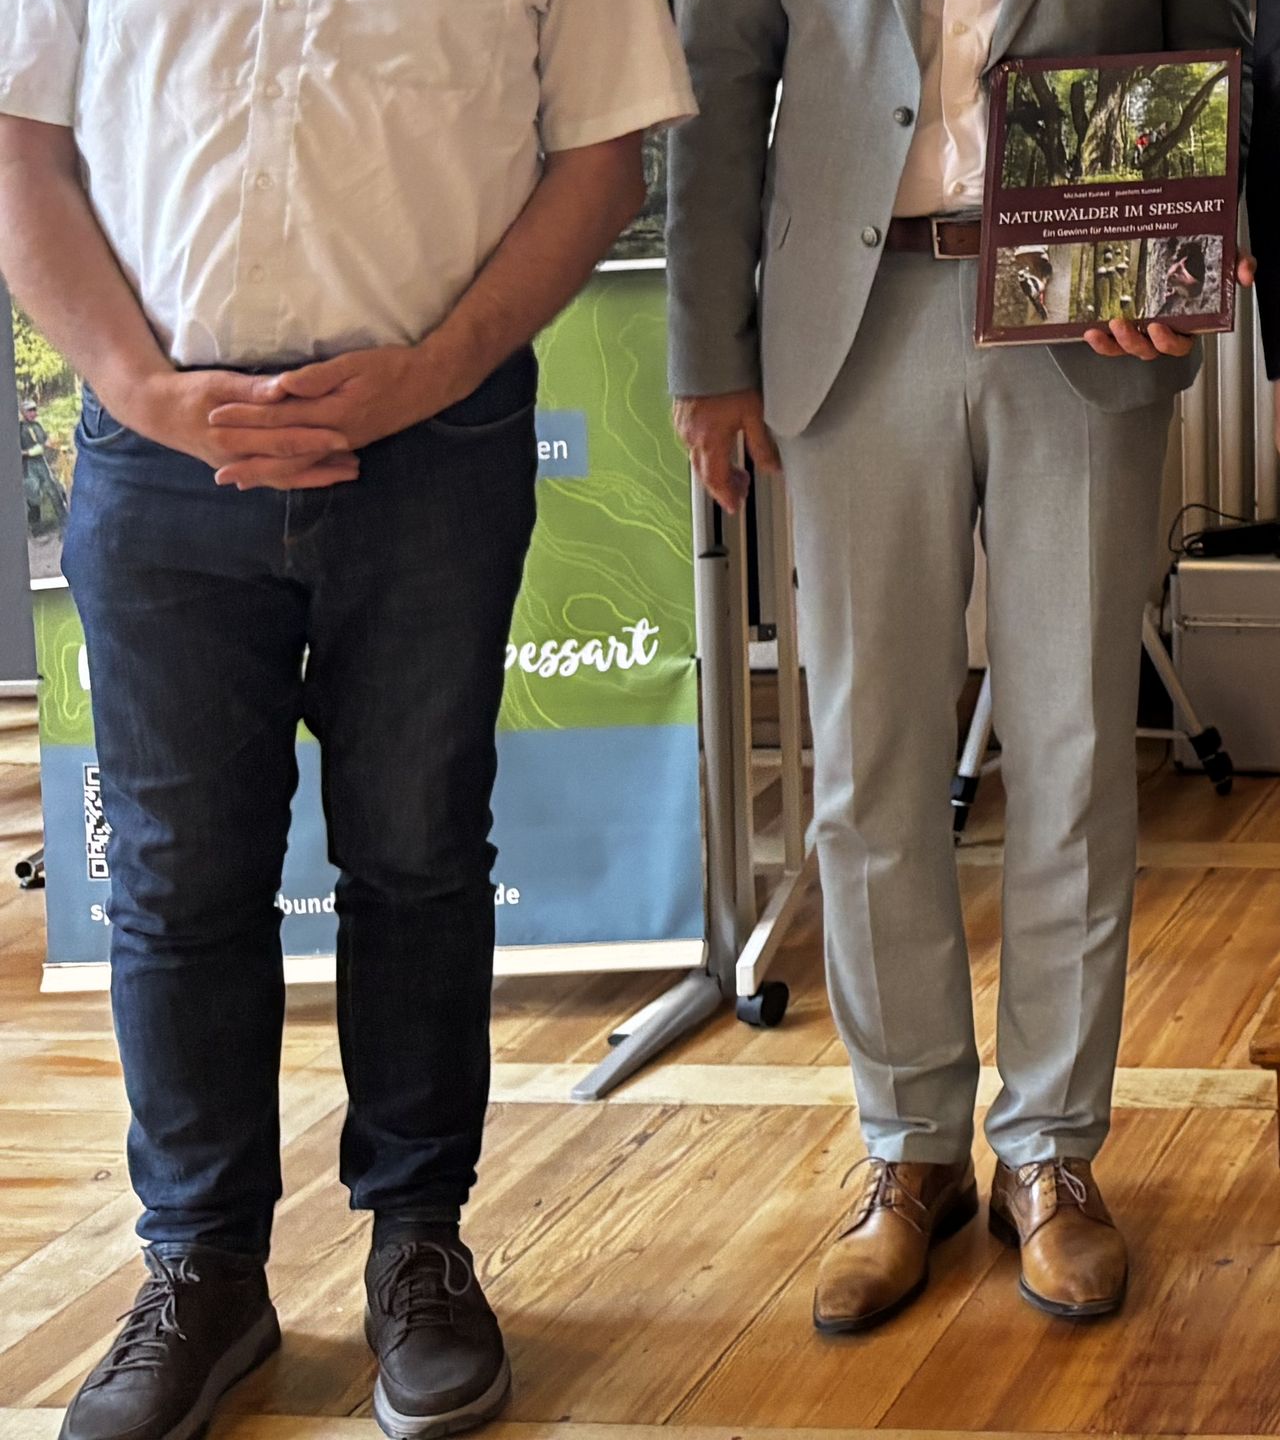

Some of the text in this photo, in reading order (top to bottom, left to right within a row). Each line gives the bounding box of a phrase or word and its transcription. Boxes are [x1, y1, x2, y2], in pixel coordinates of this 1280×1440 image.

[999, 199, 1224, 224] NATURWÄLDER IM SPESSART
[1043, 222, 1178, 238] Ein Gewinn für Mensch und Natur
